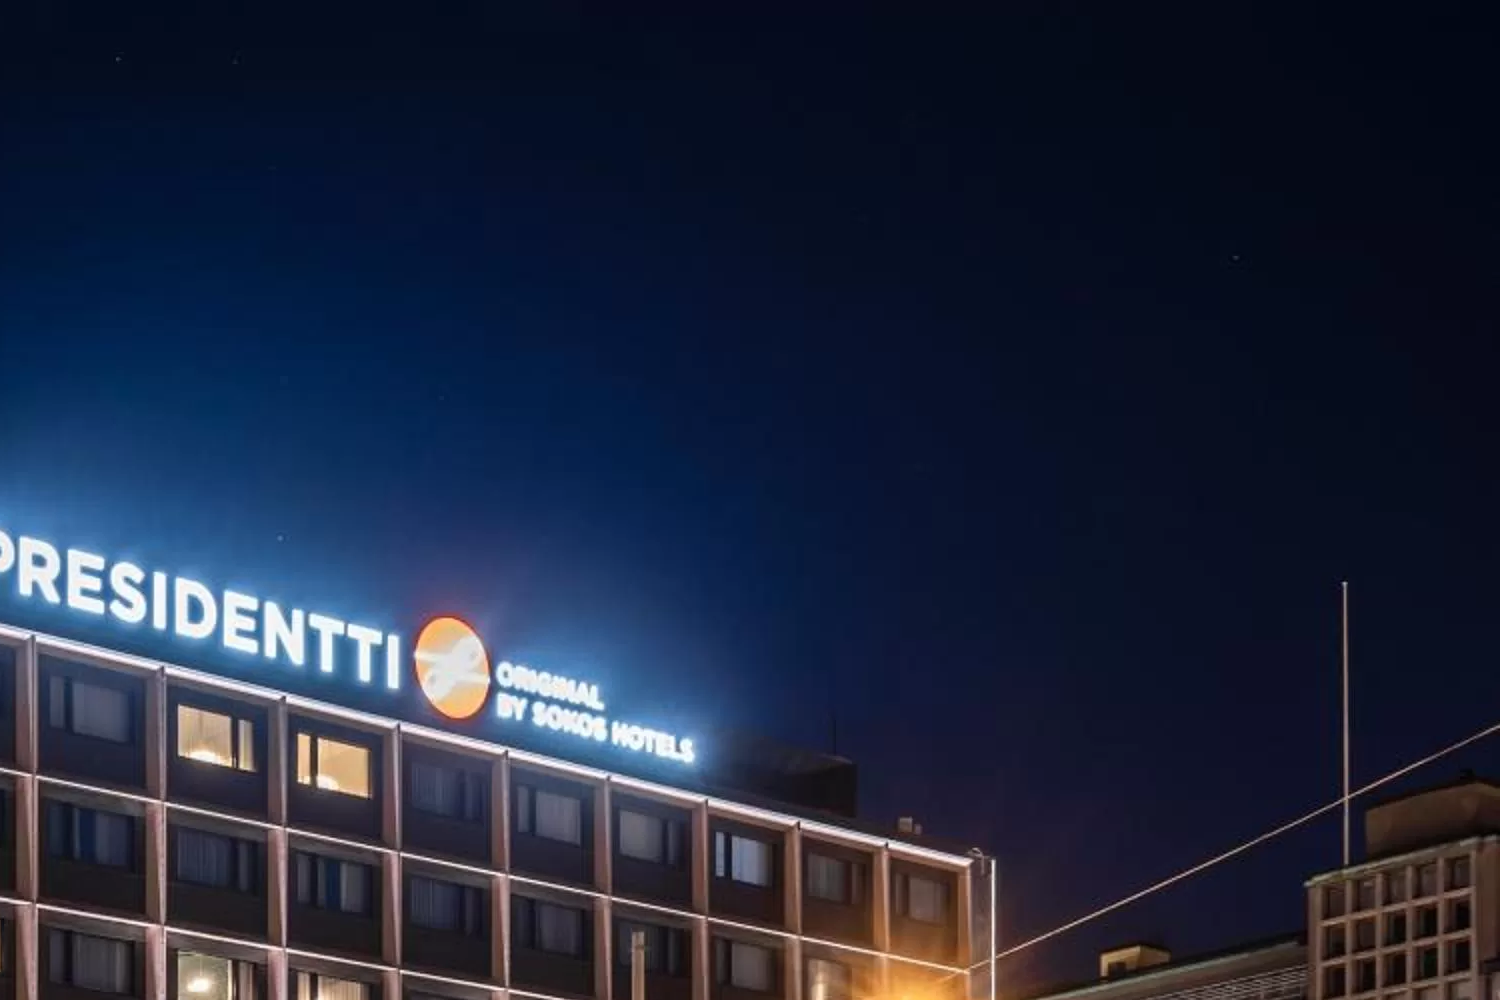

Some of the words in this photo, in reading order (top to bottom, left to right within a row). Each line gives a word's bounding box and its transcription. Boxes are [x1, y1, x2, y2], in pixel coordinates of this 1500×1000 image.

[496, 661, 605, 710] ORIGINAL
[496, 692, 528, 720] BY
[532, 701, 608, 741] SOKOS
[611, 721, 695, 763] HOTELS
